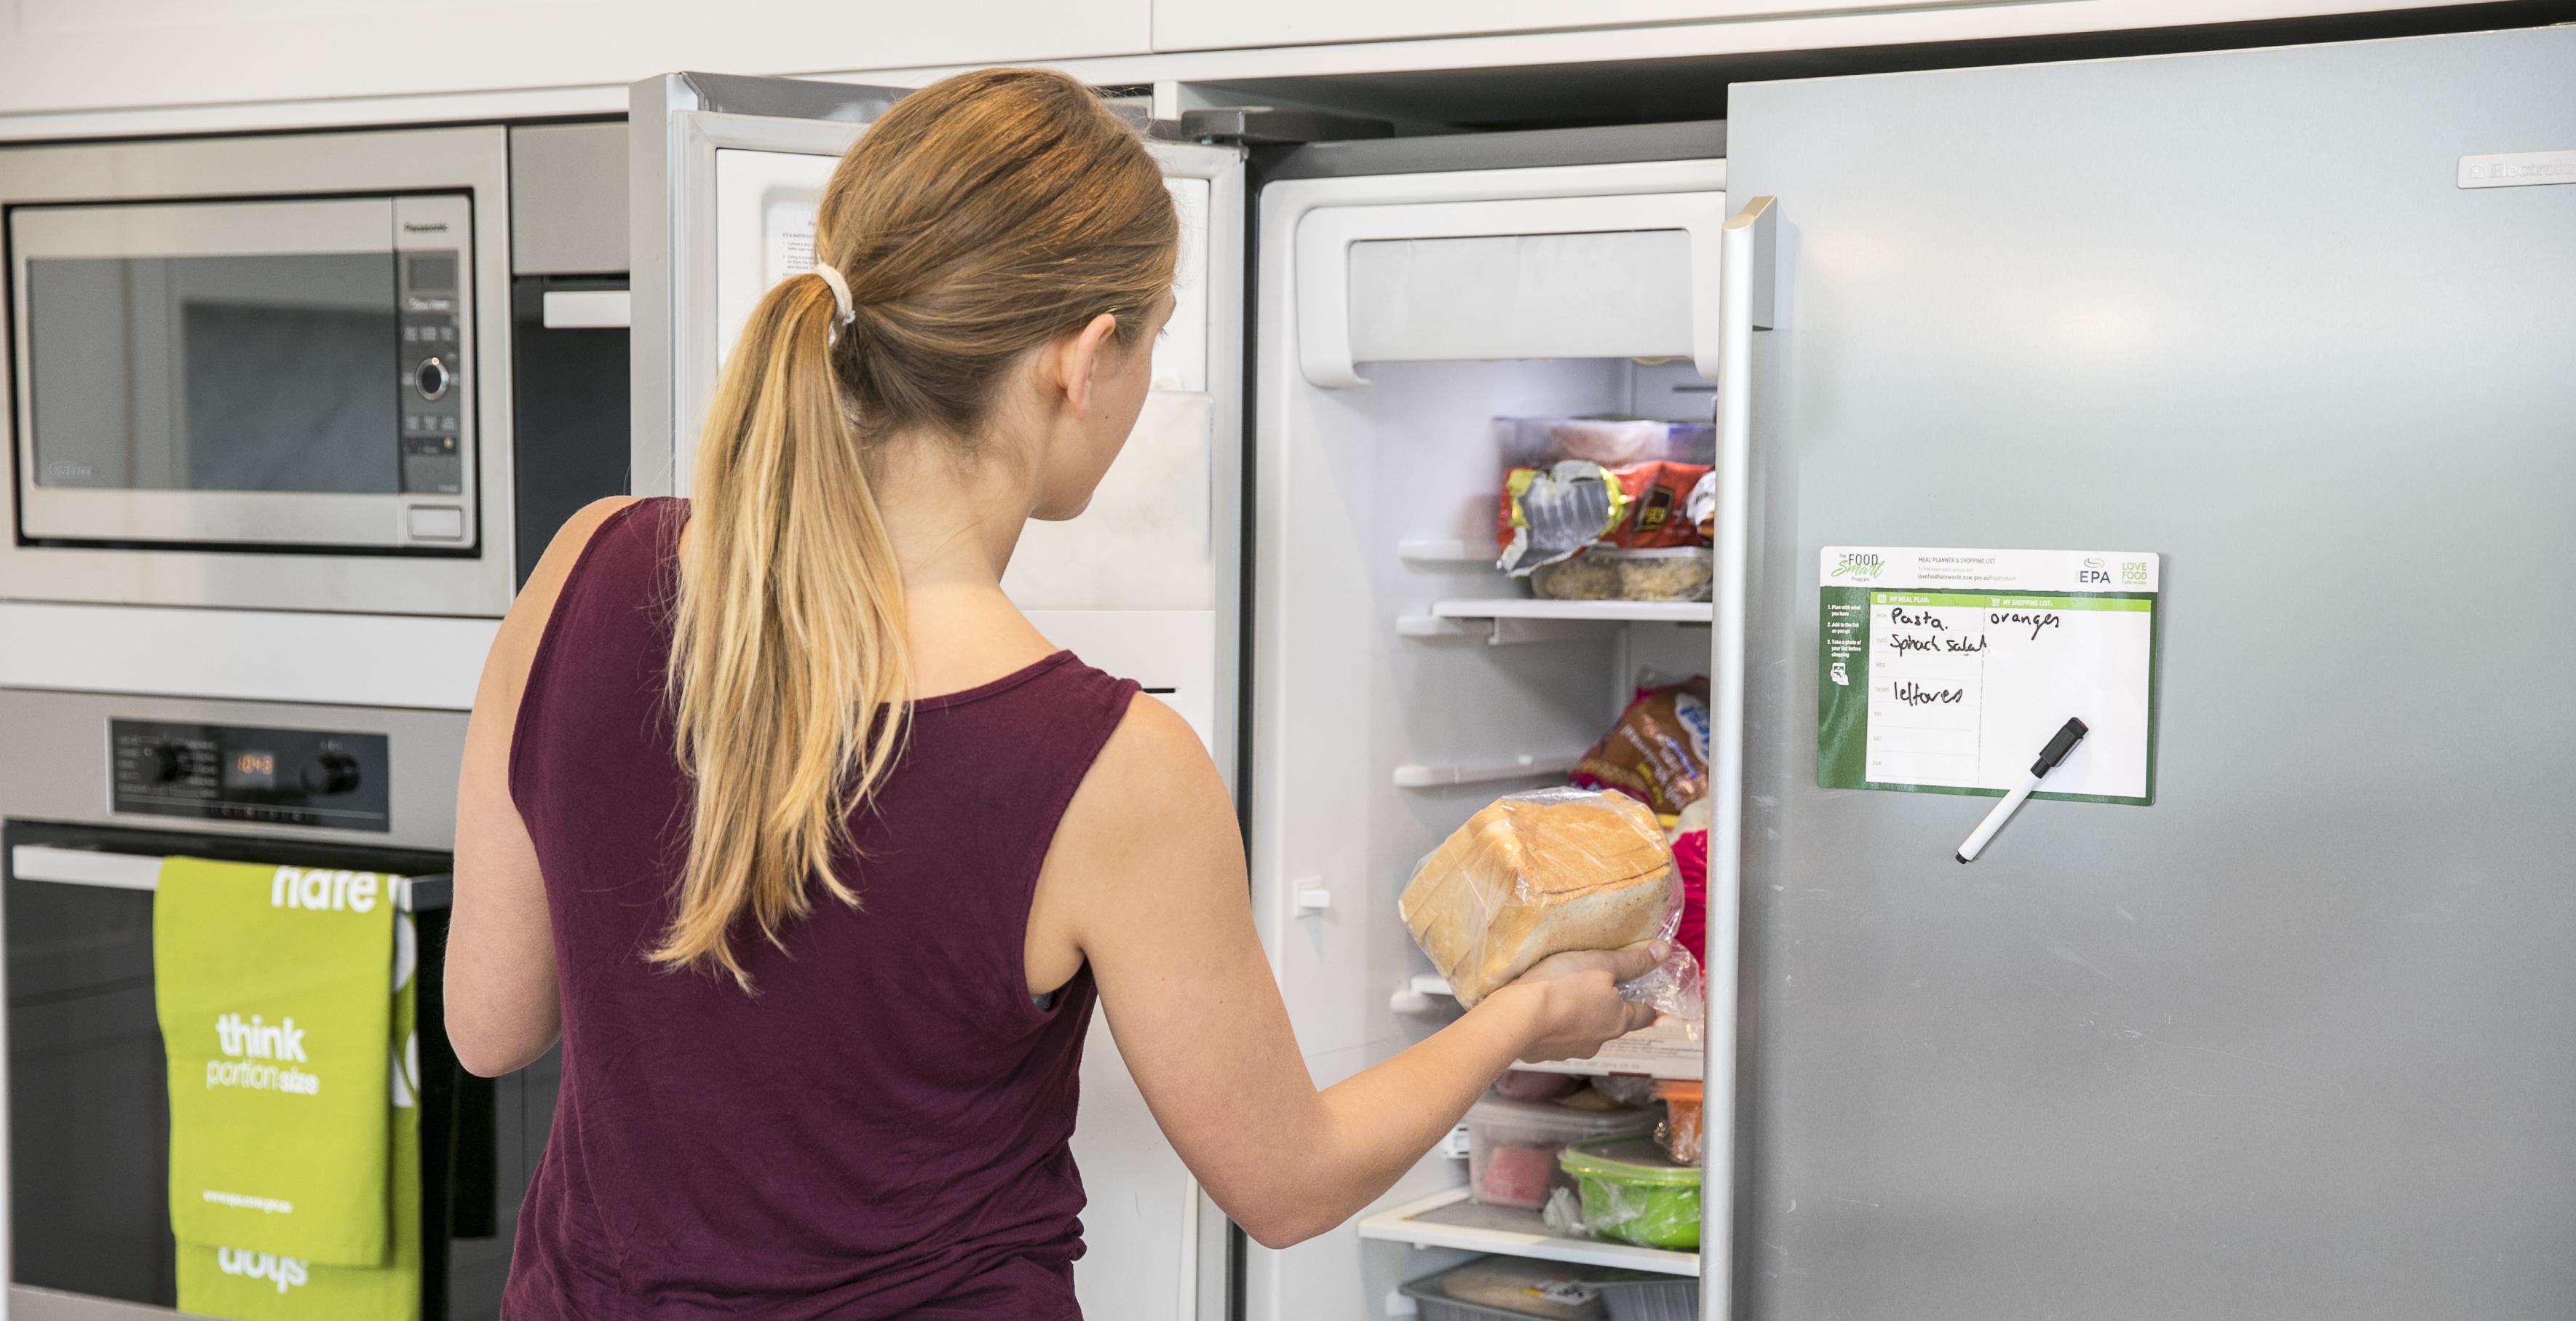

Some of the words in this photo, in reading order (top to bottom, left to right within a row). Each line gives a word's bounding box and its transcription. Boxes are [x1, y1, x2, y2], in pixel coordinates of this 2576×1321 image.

[2490, 158, 2575, 178] Electrolu
[1848, 554, 1878, 566] FOOD
[2122, 563, 2147, 571] LOVE
[1831, 560, 1885, 579] Smart
[2080, 571, 2111, 583] EPA
[2122, 571, 2147, 580] FOOD
[215, 1013, 308, 1063] think
[206, 1060, 279, 1091] portion
[279, 1068, 320, 1095] size
